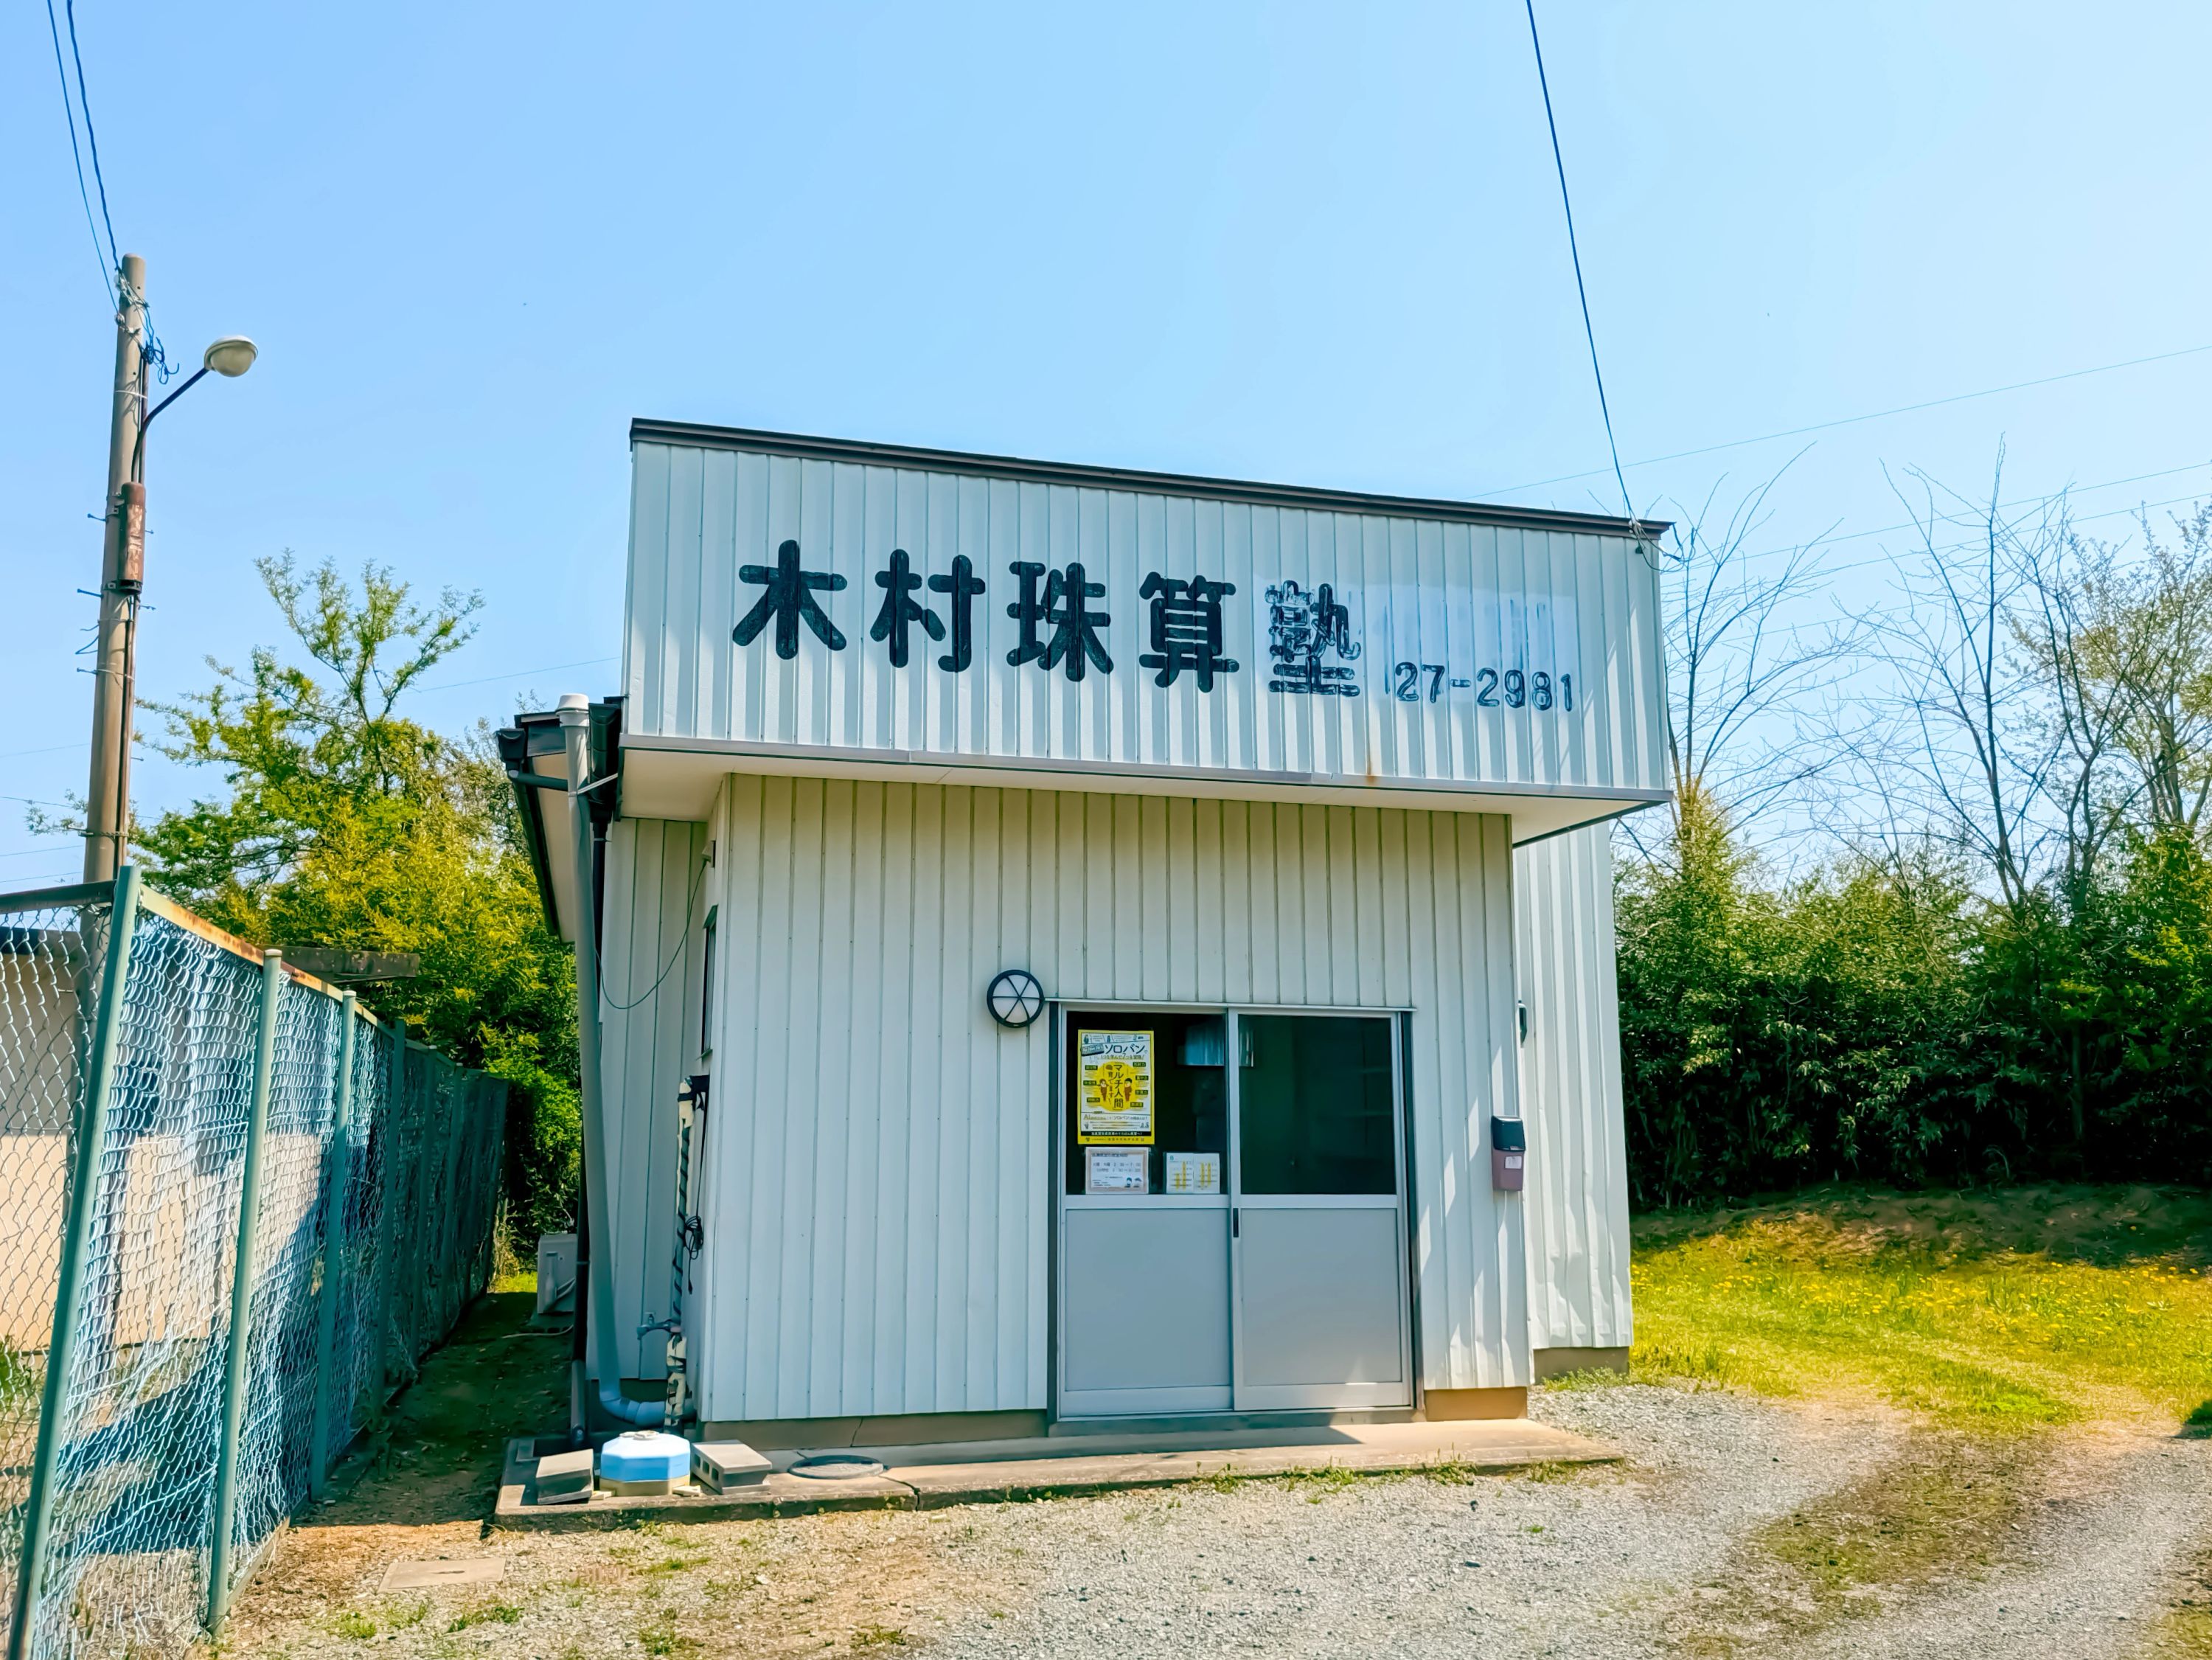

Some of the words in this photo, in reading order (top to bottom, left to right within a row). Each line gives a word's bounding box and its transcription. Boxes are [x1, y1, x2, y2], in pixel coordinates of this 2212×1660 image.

[732, 540, 1361, 697] 木村珠算塾
[1394, 661, 1573, 712] 27-2981
